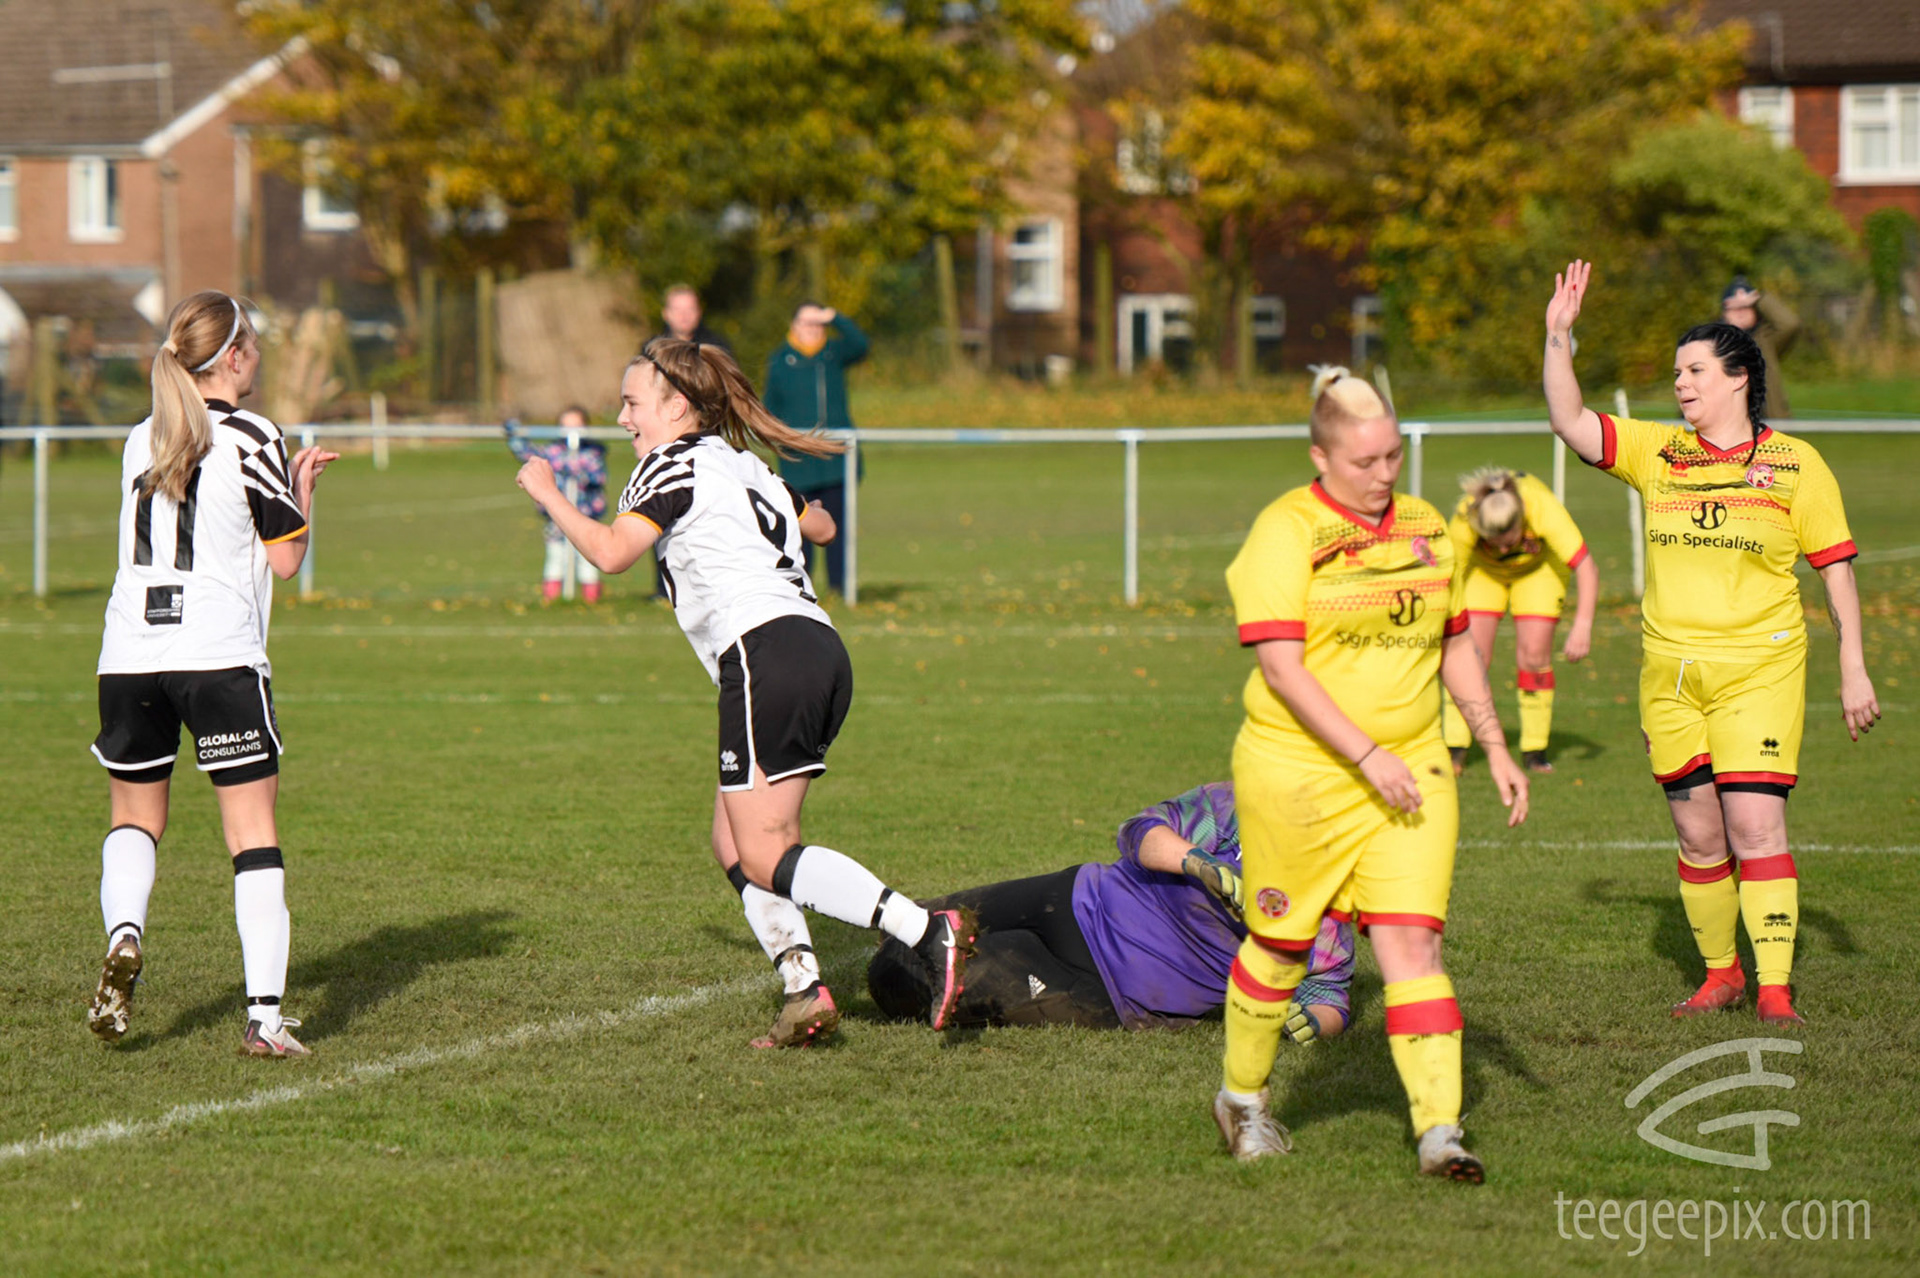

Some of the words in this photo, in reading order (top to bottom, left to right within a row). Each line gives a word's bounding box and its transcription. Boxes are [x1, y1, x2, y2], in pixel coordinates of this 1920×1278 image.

[132, 466, 202, 572] 11
[746, 487, 795, 569] 9
[1649, 529, 1678, 547] Sign
[1682, 532, 1765, 555] Specialists
[1335, 630, 1371, 650] Sign
[198, 729, 260, 748] GLOBAL-QA
[199, 741, 262, 760] CONSULTANTS
